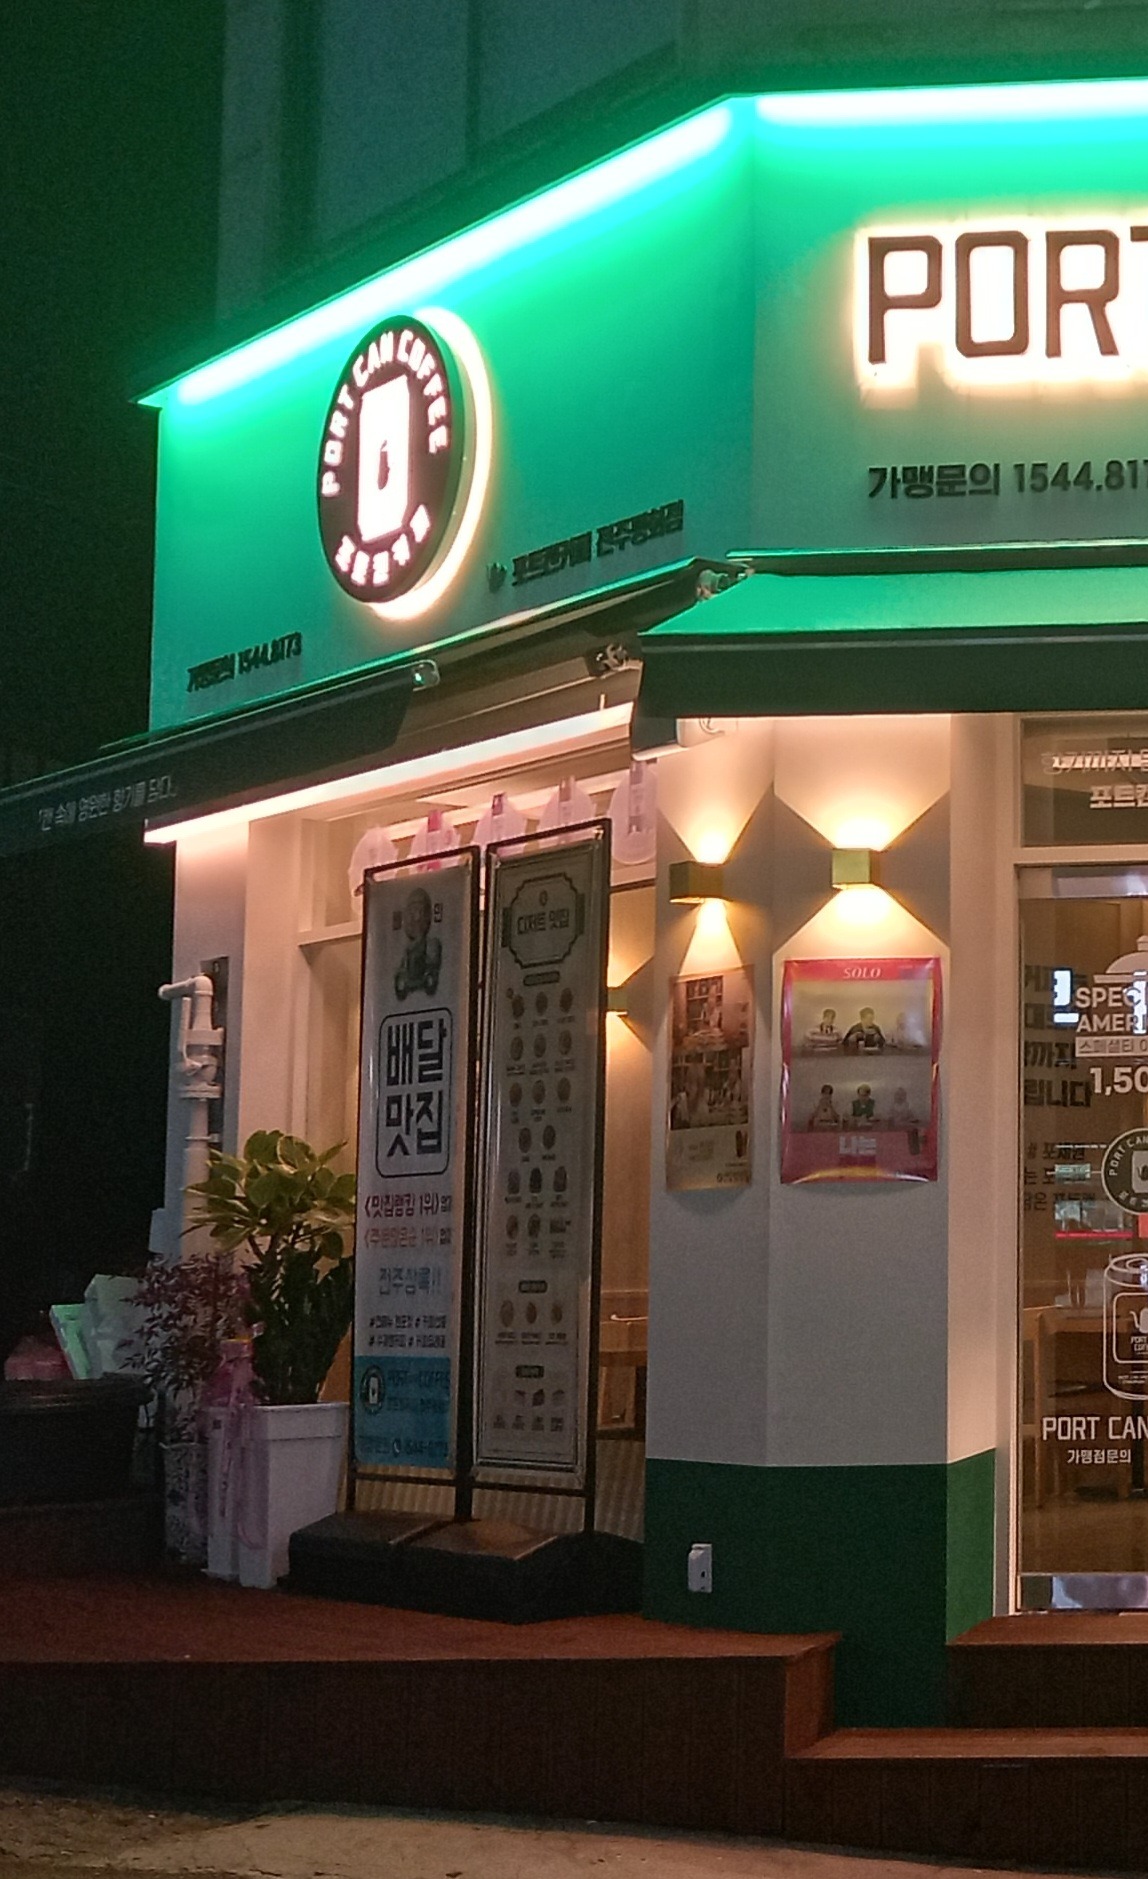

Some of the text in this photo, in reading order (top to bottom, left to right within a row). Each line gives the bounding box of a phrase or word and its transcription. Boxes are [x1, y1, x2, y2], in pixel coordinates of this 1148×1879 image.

[321, 329, 448, 497] PORT CAN COFFEE
[868, 463, 1000, 499] 가맹문의
[843, 967, 881, 979] SOLO
[386, 1018, 447, 1087] 배달
[385, 1090, 444, 1158] 맛집
[1109, 1145, 1125, 1176] PORT
[1042, 1416, 1100, 1440] PORT
[1068, 1449, 1131, 1464] 가맹점문의
